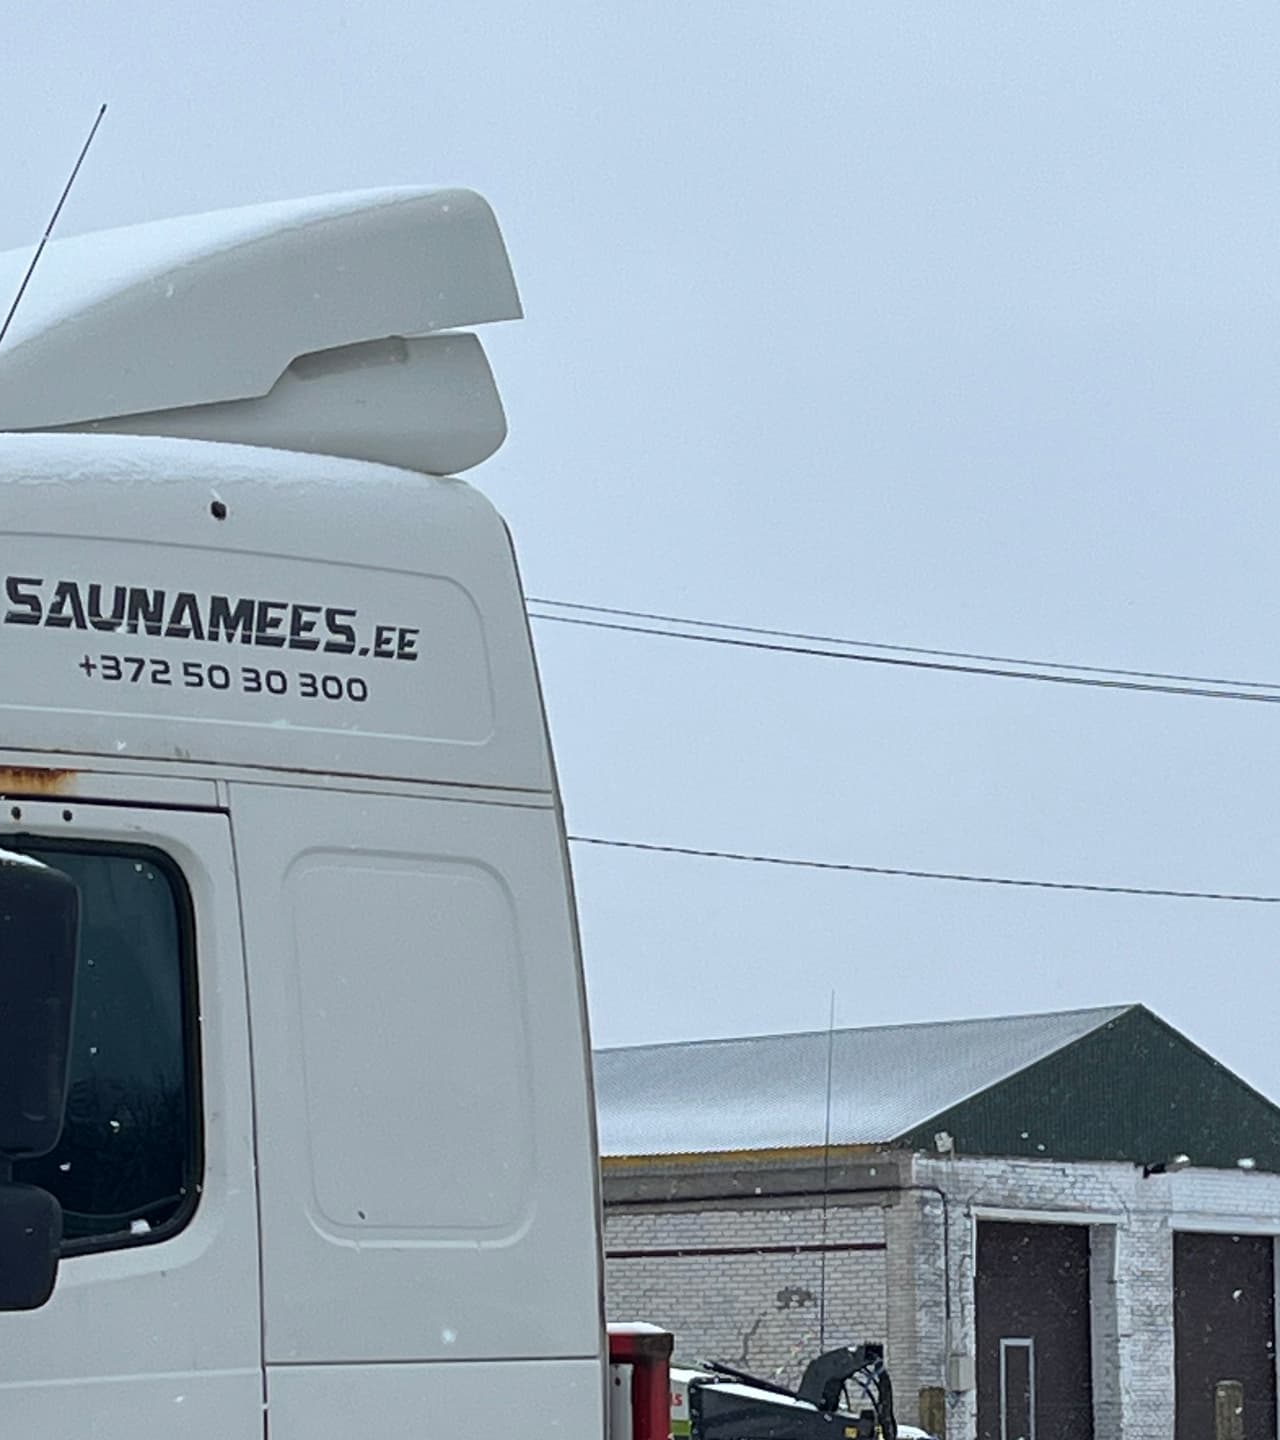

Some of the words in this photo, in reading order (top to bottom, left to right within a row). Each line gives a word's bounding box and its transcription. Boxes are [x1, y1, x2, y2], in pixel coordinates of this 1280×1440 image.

[3, 576, 420, 661] SAUNAMEES.EE
[78, 654, 172, 686] +372
[182, 661, 230, 690] 50
[241, 666, 288, 696] 30
[298, 672, 368, 702] 300
